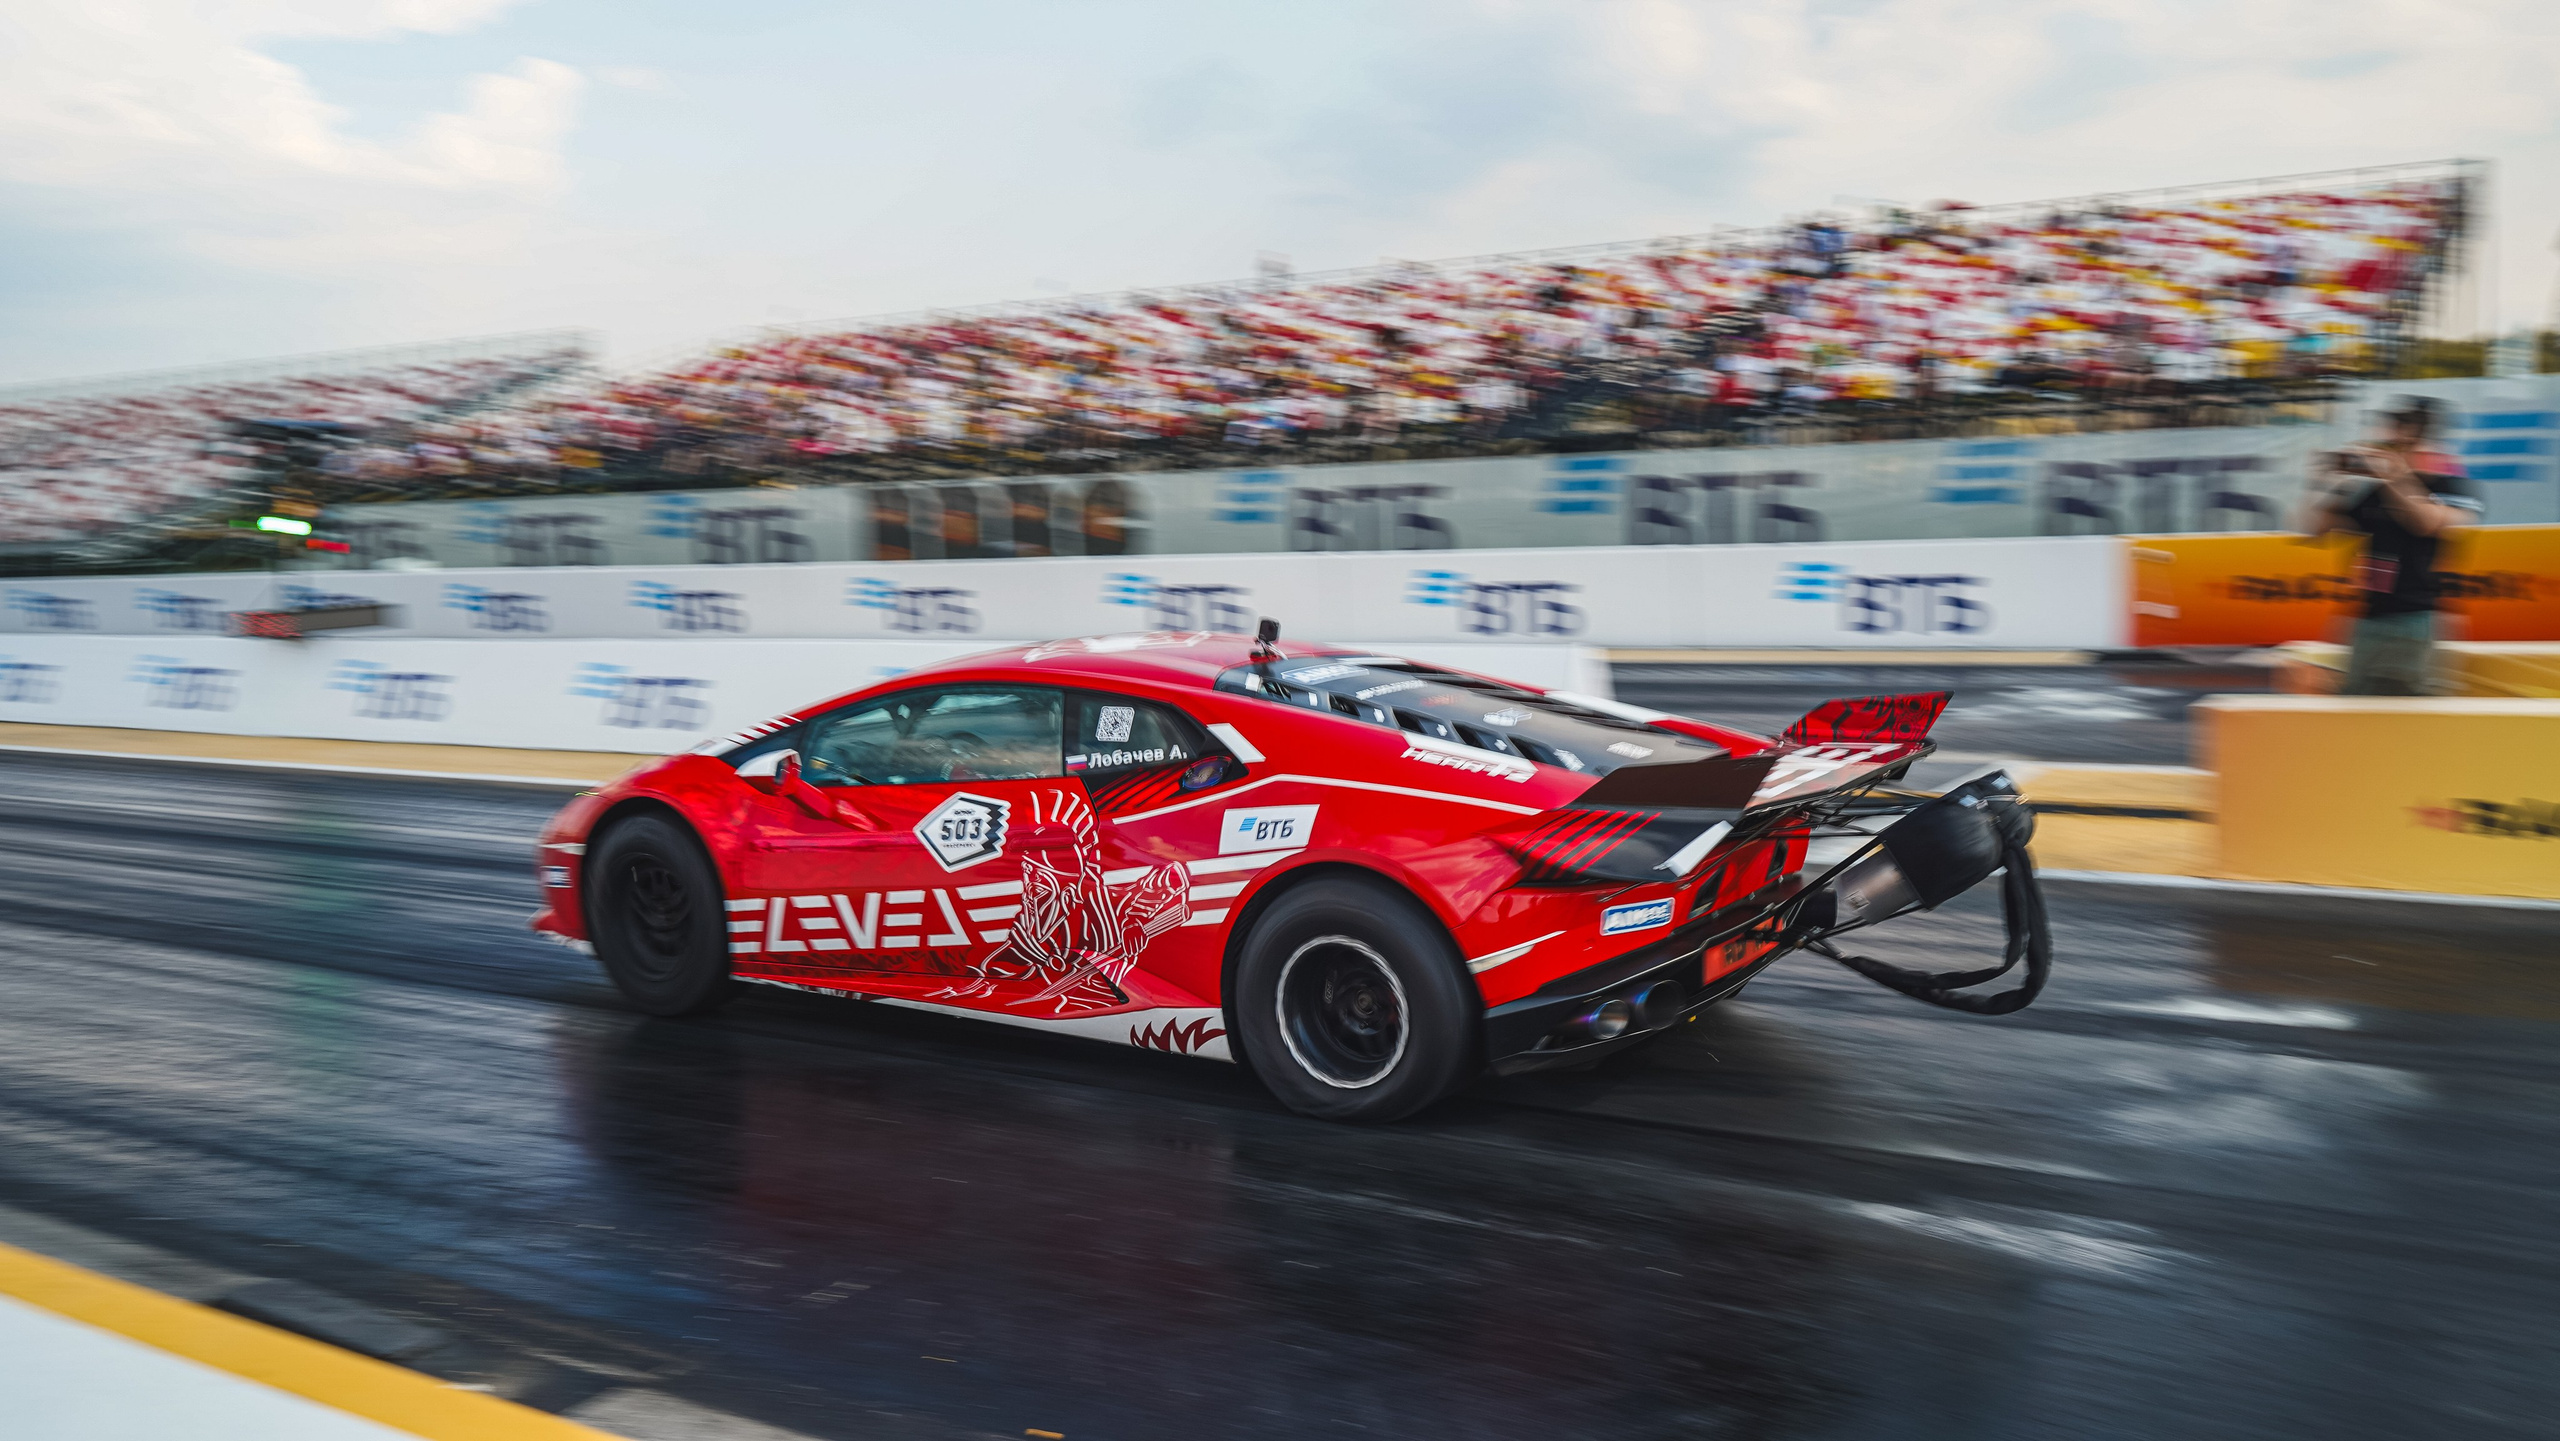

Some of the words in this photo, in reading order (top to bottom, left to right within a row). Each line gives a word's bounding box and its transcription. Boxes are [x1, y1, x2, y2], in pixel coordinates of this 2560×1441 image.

[1836, 572, 1996, 634] ВТБ
[1088, 748, 1165, 769] Лобачев
[941, 818, 983, 841] 503
[1256, 818, 1296, 841] ВТБ
